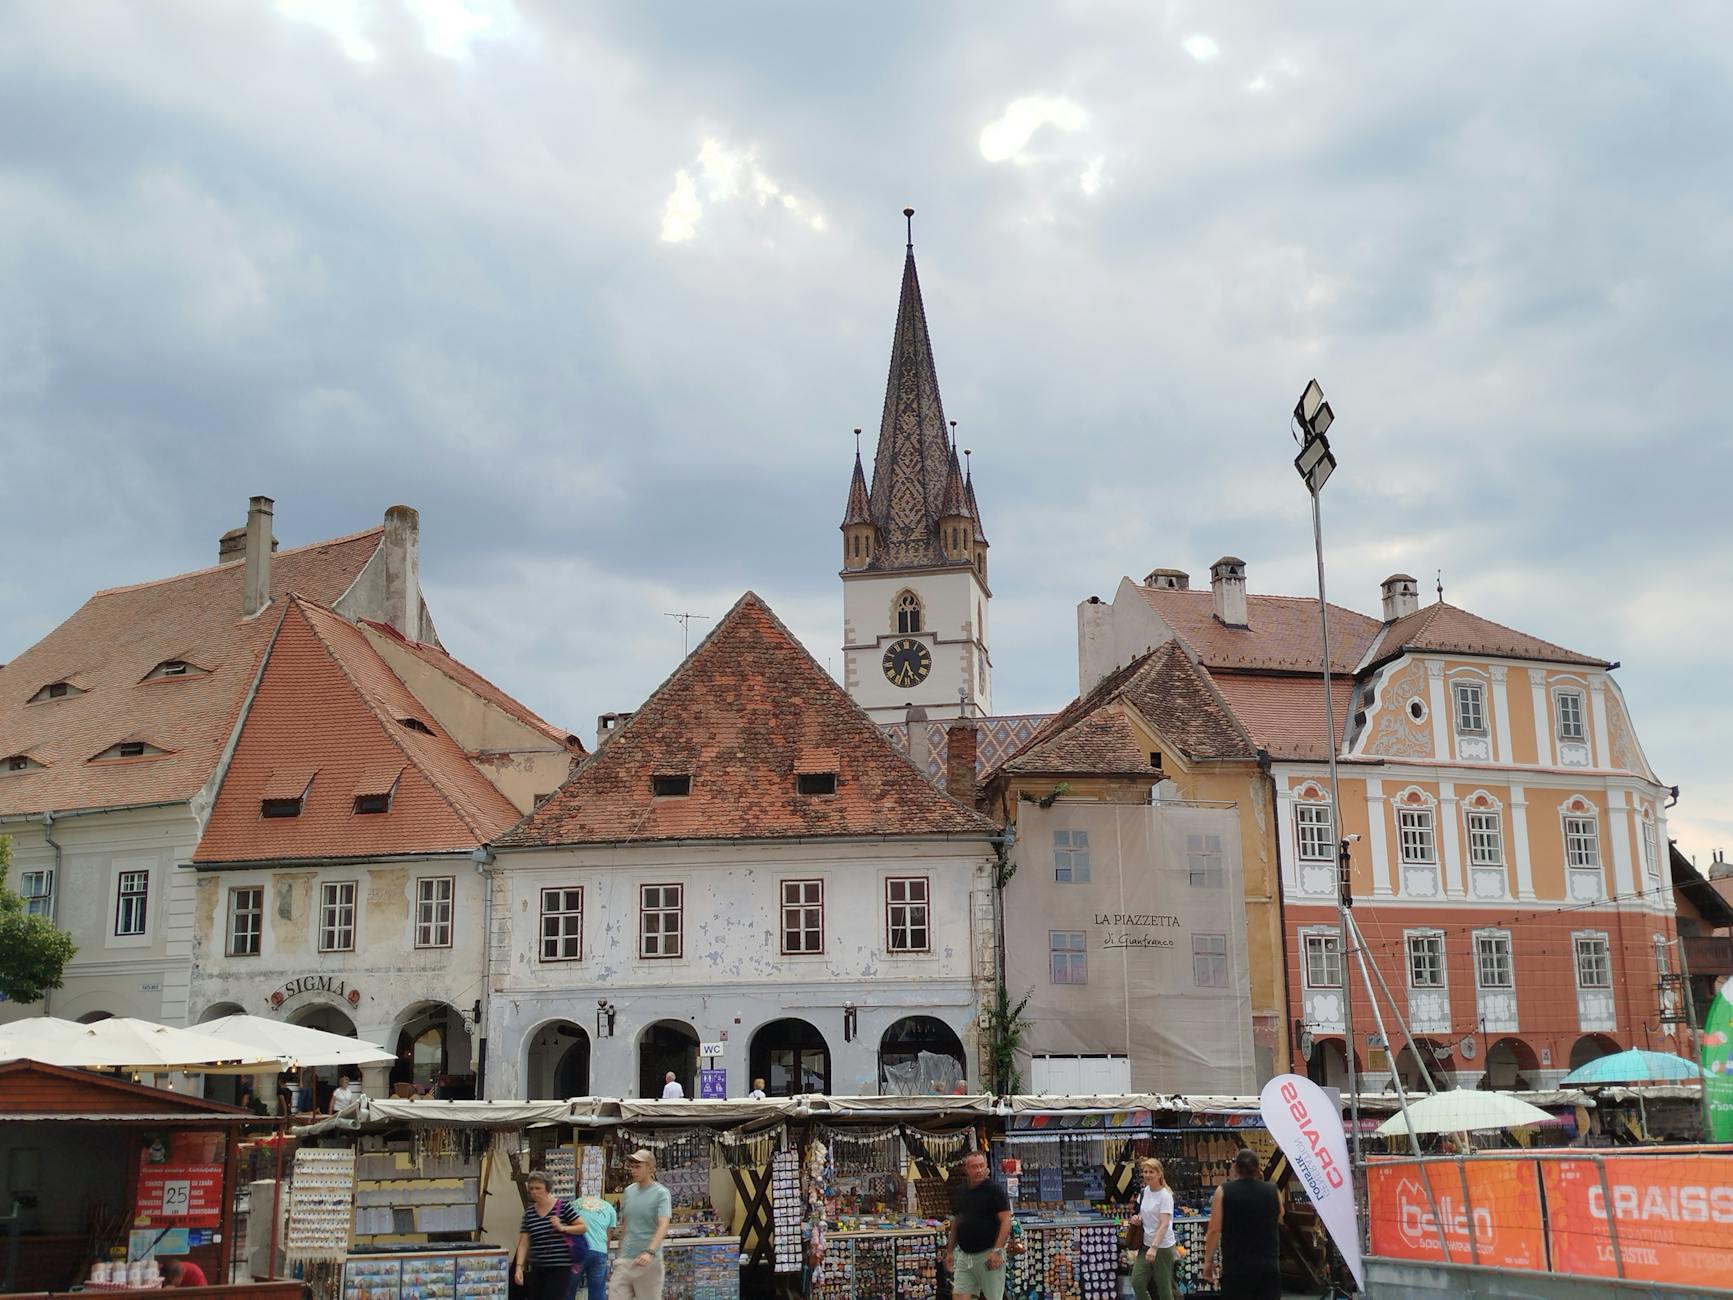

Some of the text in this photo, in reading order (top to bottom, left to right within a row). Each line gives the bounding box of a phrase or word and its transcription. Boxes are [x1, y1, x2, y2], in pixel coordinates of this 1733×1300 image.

[1095, 914, 1180, 927] LA PIAZZETTA
[286, 976, 345, 997] SIGMA
[704, 1045, 721, 1053] WC
[166, 1187, 188, 1205] 25
[1588, 1185, 1733, 1223] CRAISS
